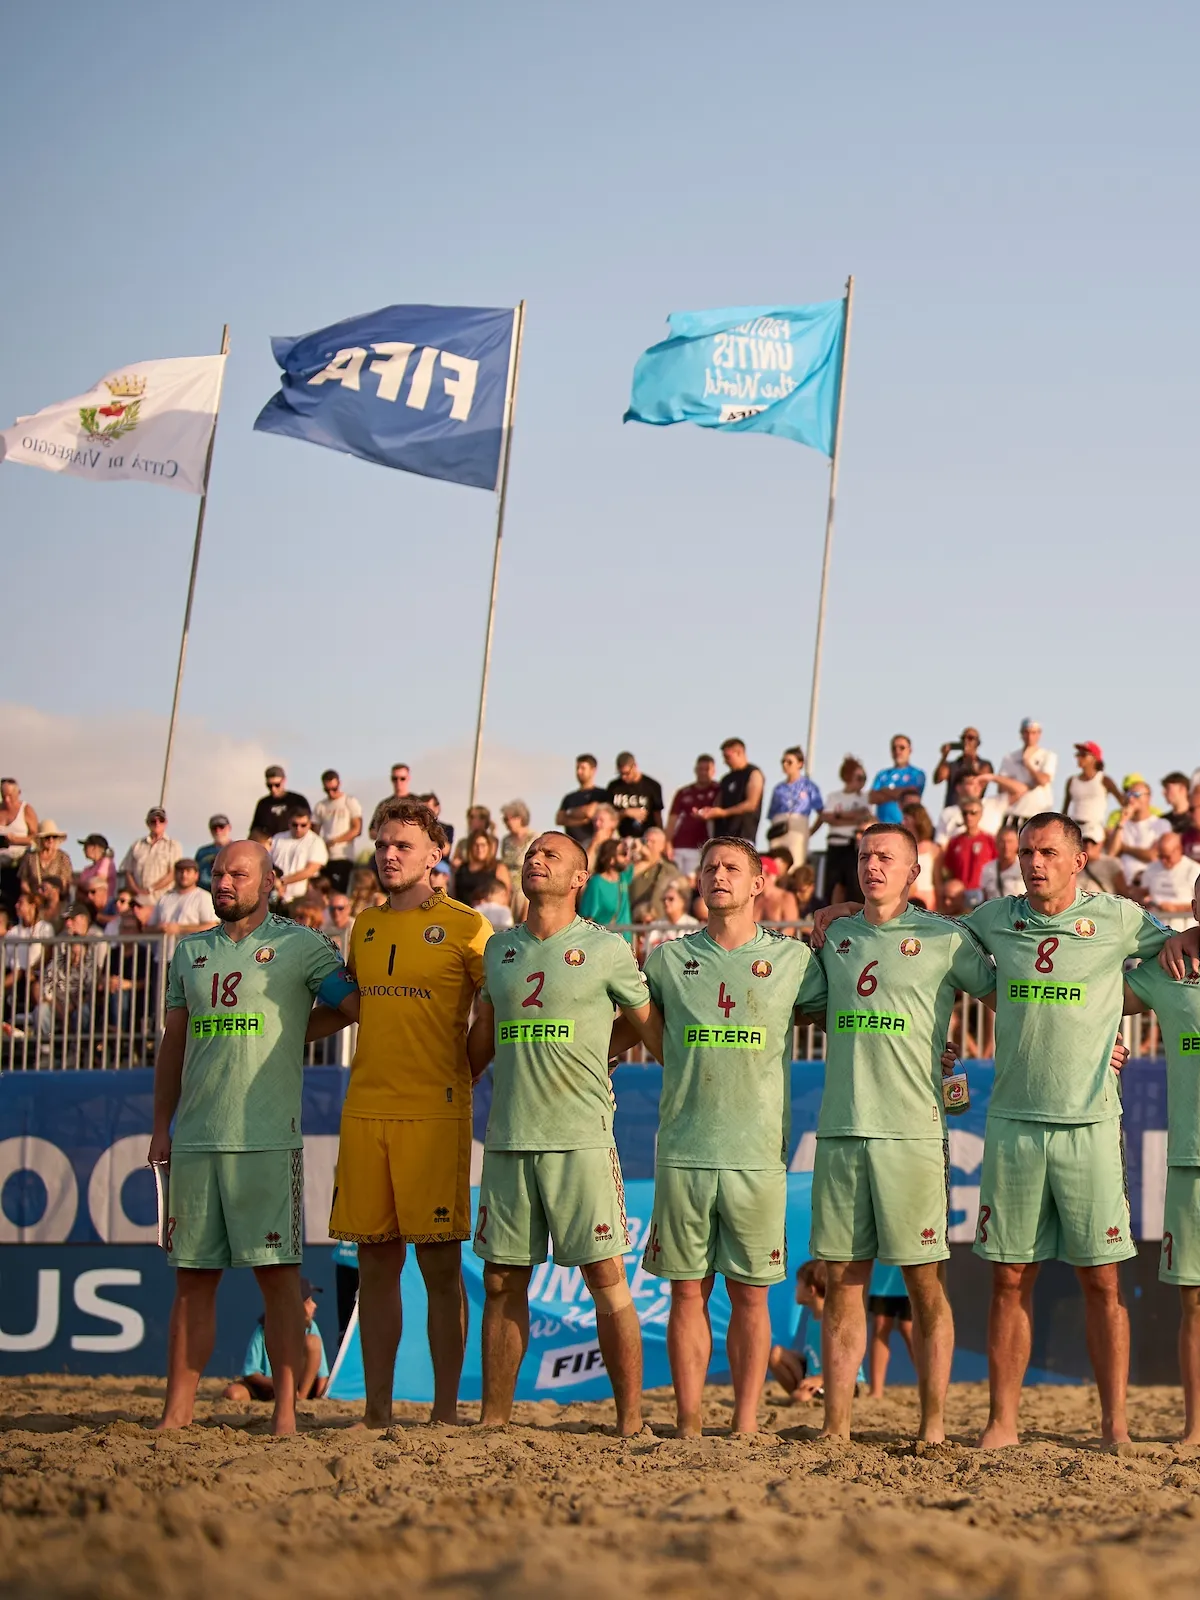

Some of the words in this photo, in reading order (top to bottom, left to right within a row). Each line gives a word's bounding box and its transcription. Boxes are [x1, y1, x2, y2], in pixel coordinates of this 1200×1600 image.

[1035, 937, 1060, 973] 8
[211, 971, 242, 1008] 18
[521, 971, 545, 1008] 2
[856, 960, 879, 997] 6
[717, 981, 736, 1018] 4
[552, 1348, 605, 1378] FIF
